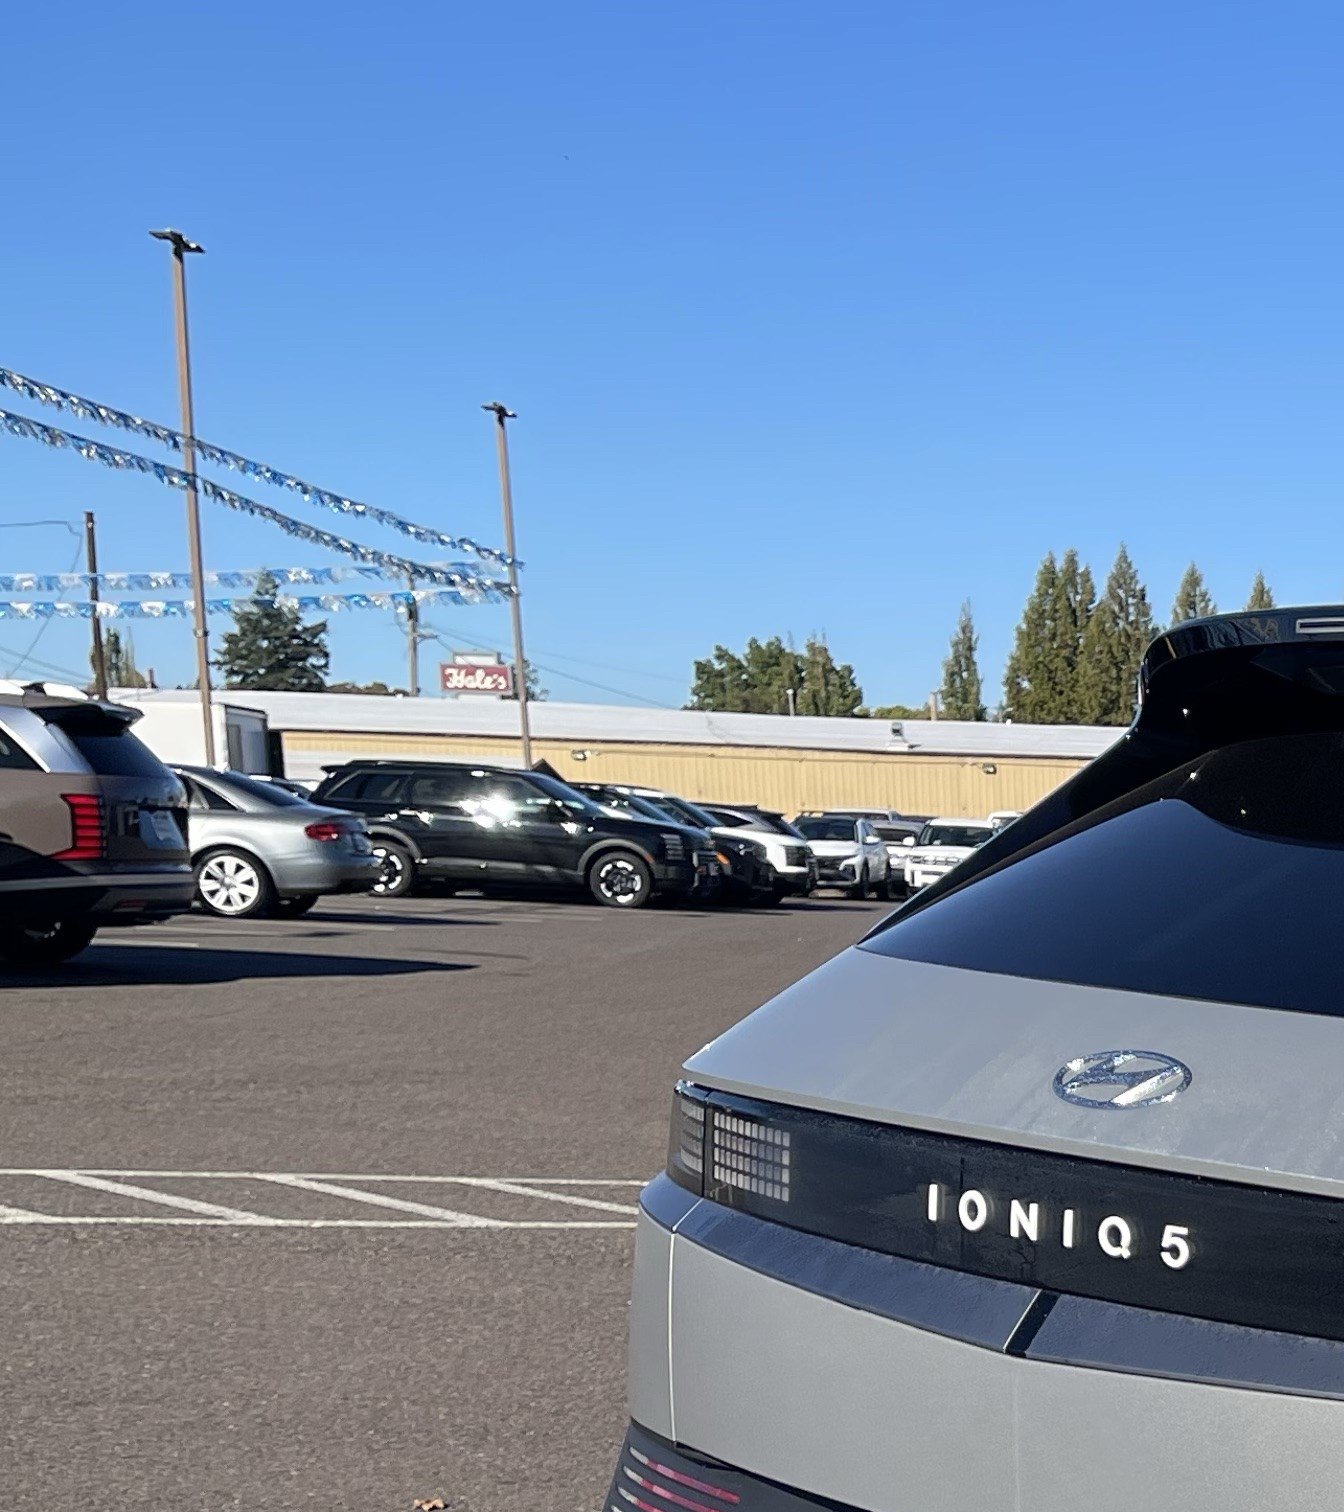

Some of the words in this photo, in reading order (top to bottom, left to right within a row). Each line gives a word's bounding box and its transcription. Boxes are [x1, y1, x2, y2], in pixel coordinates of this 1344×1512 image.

[443, 667, 508, 690] Hale's
[927, 1183, 1132, 1260] IONIQ
[1160, 1224, 1191, 1270] 5
